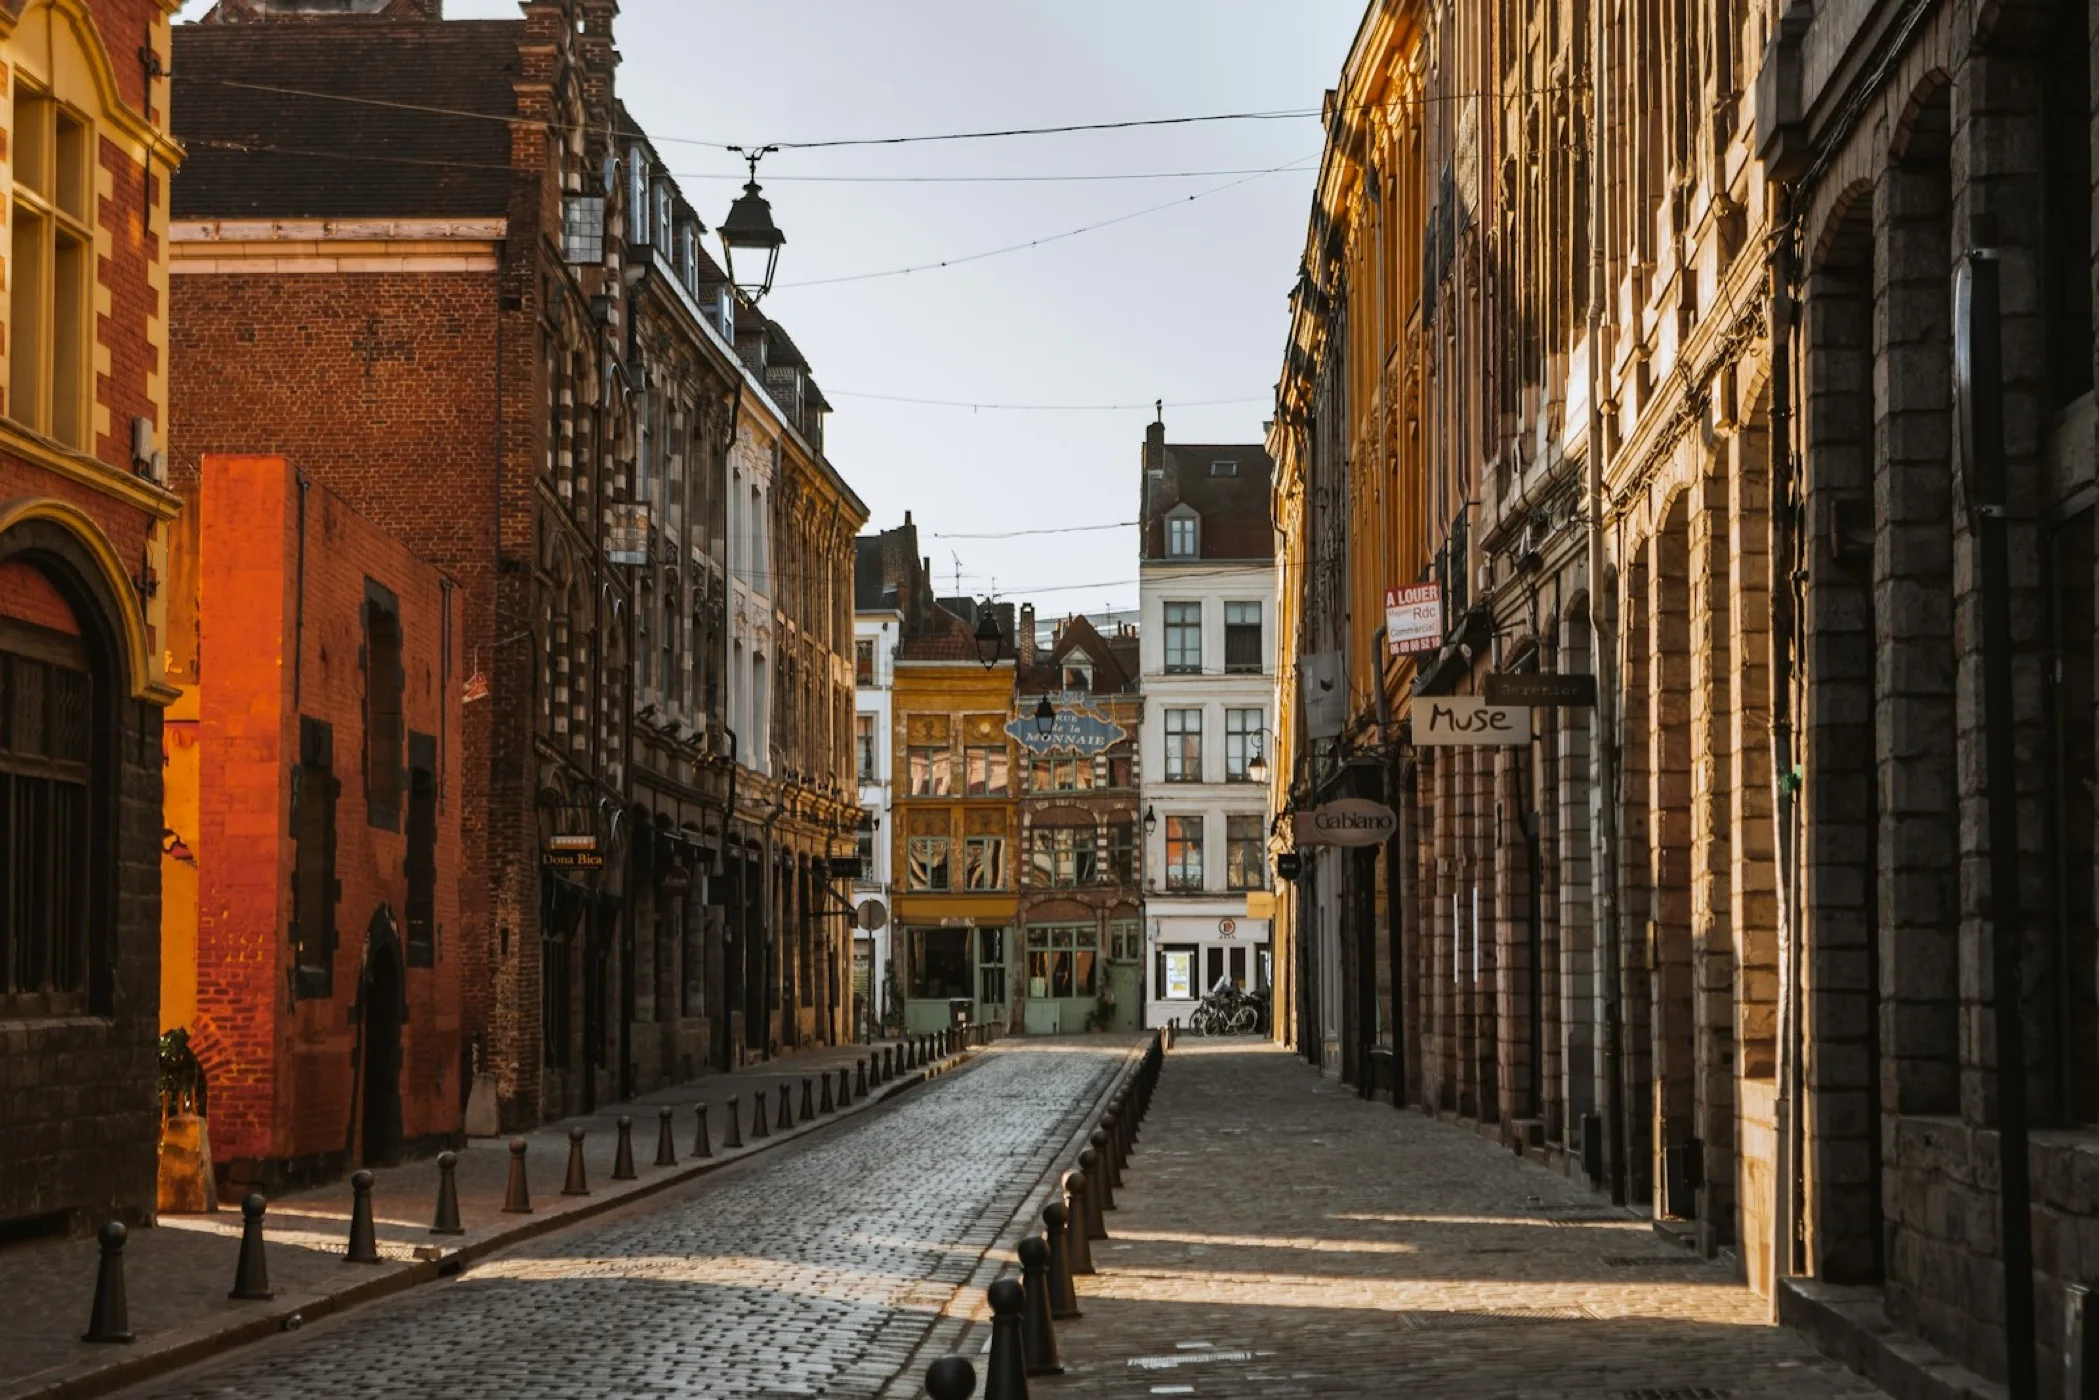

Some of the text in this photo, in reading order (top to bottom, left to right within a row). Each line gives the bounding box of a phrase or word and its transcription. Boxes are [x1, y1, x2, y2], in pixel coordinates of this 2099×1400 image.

[1387, 584, 1438, 606] A LOUER
[1412, 605, 1436, 620] Rdc
[1429, 703, 1513, 732] Muse
[1026, 732, 1104, 745] MONNAIE
[1315, 812, 1392, 829] Gabiano
[543, 853, 603, 865] Dona Bica
